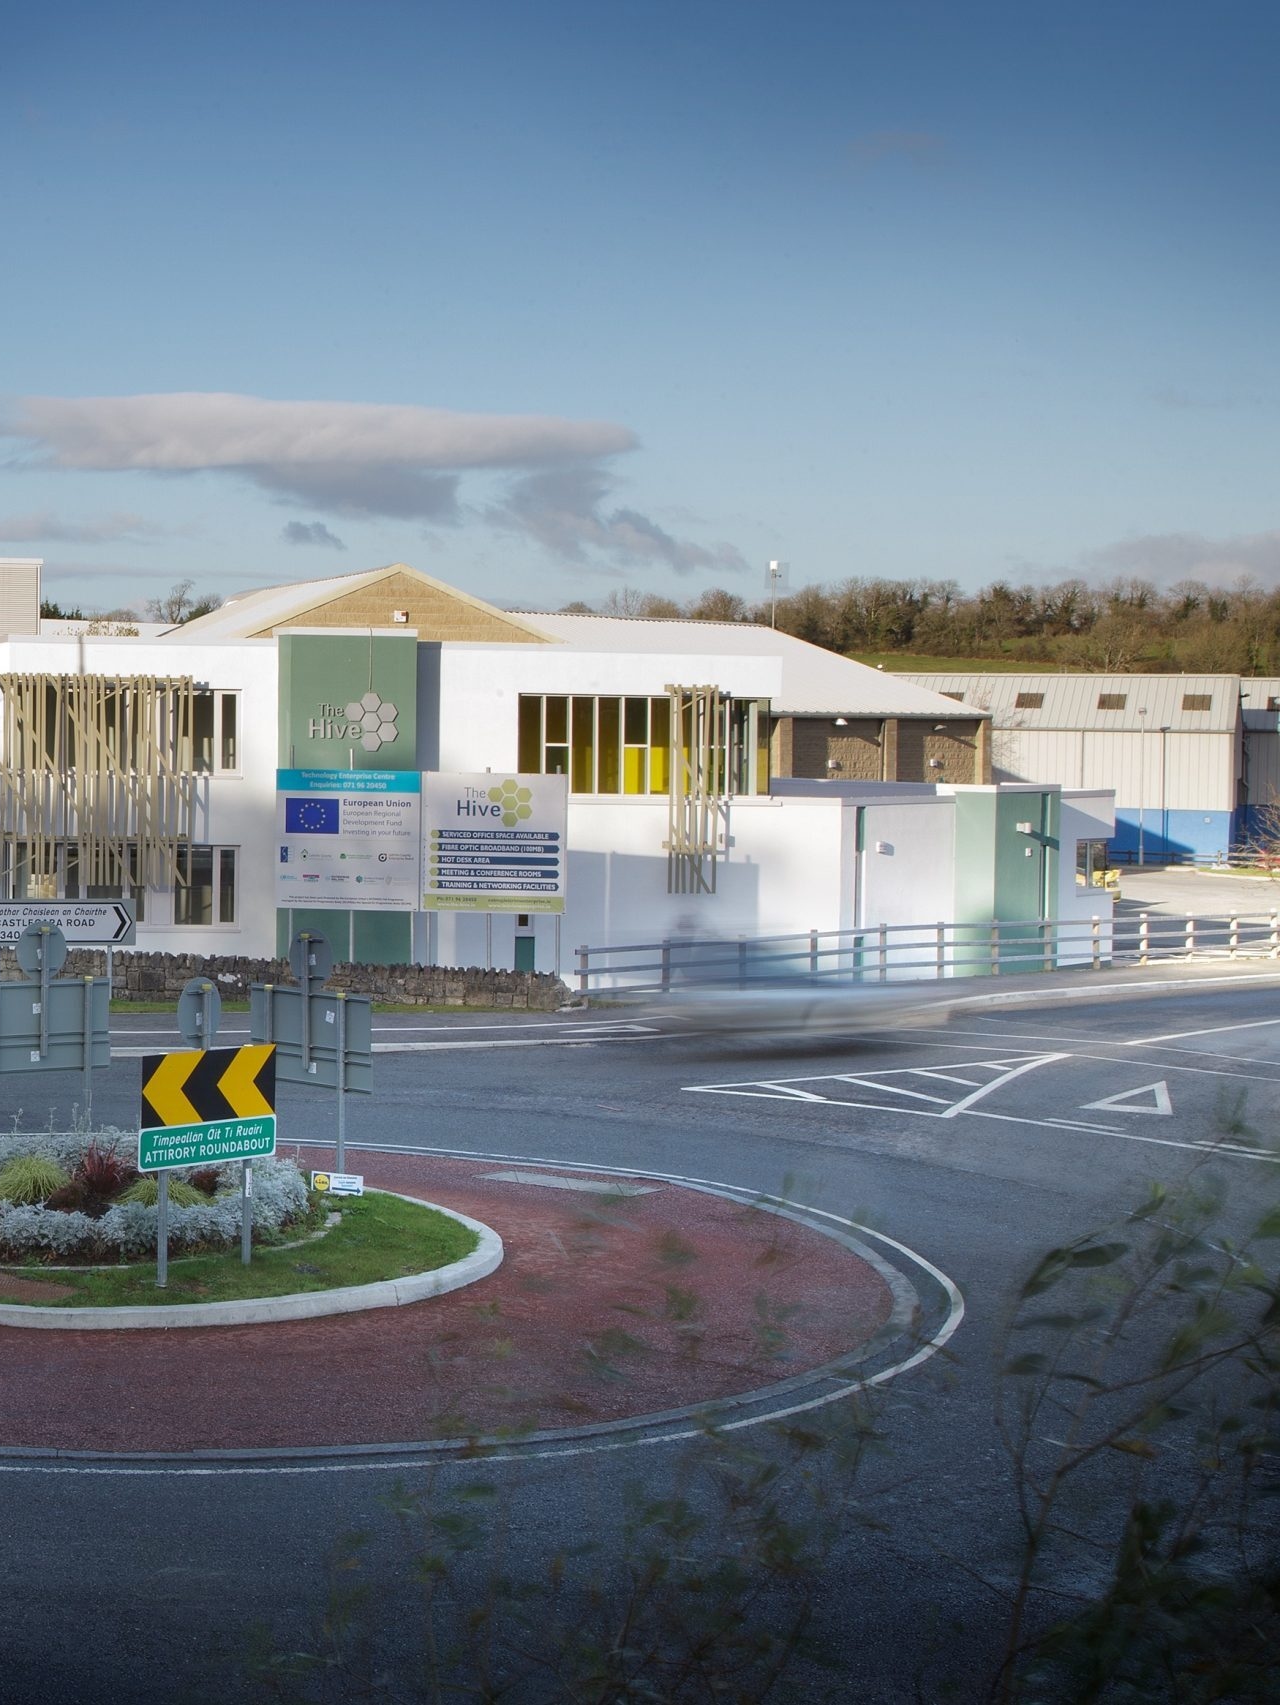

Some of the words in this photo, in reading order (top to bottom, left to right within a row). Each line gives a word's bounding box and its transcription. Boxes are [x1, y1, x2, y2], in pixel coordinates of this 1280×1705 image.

[319, 703, 345, 717] The
[308, 718, 362, 739] Hive
[301, 772, 338, 780] Technology
[310, 781, 341, 789] Enquiries:
[464, 787, 486, 799] The
[343, 798, 384, 808] European
[386, 799, 412, 808] Union
[457, 800, 501, 817] Hive
[343, 810, 373, 818] European
[374, 810, 402, 819] Regional
[343, 820, 385, 828] Development
[342, 828, 369, 837] Investing
[377, 830, 391, 838] your
[392, 829, 411, 837] future
[441, 881, 472, 889] TRAINING
[74, 907, 108, 916] Chairthe
[66, 919, 96, 927] ROAD
[144, 1145, 197, 1163] ATTIRORY
[199, 1137, 271, 1156] ROUNDABOUT
